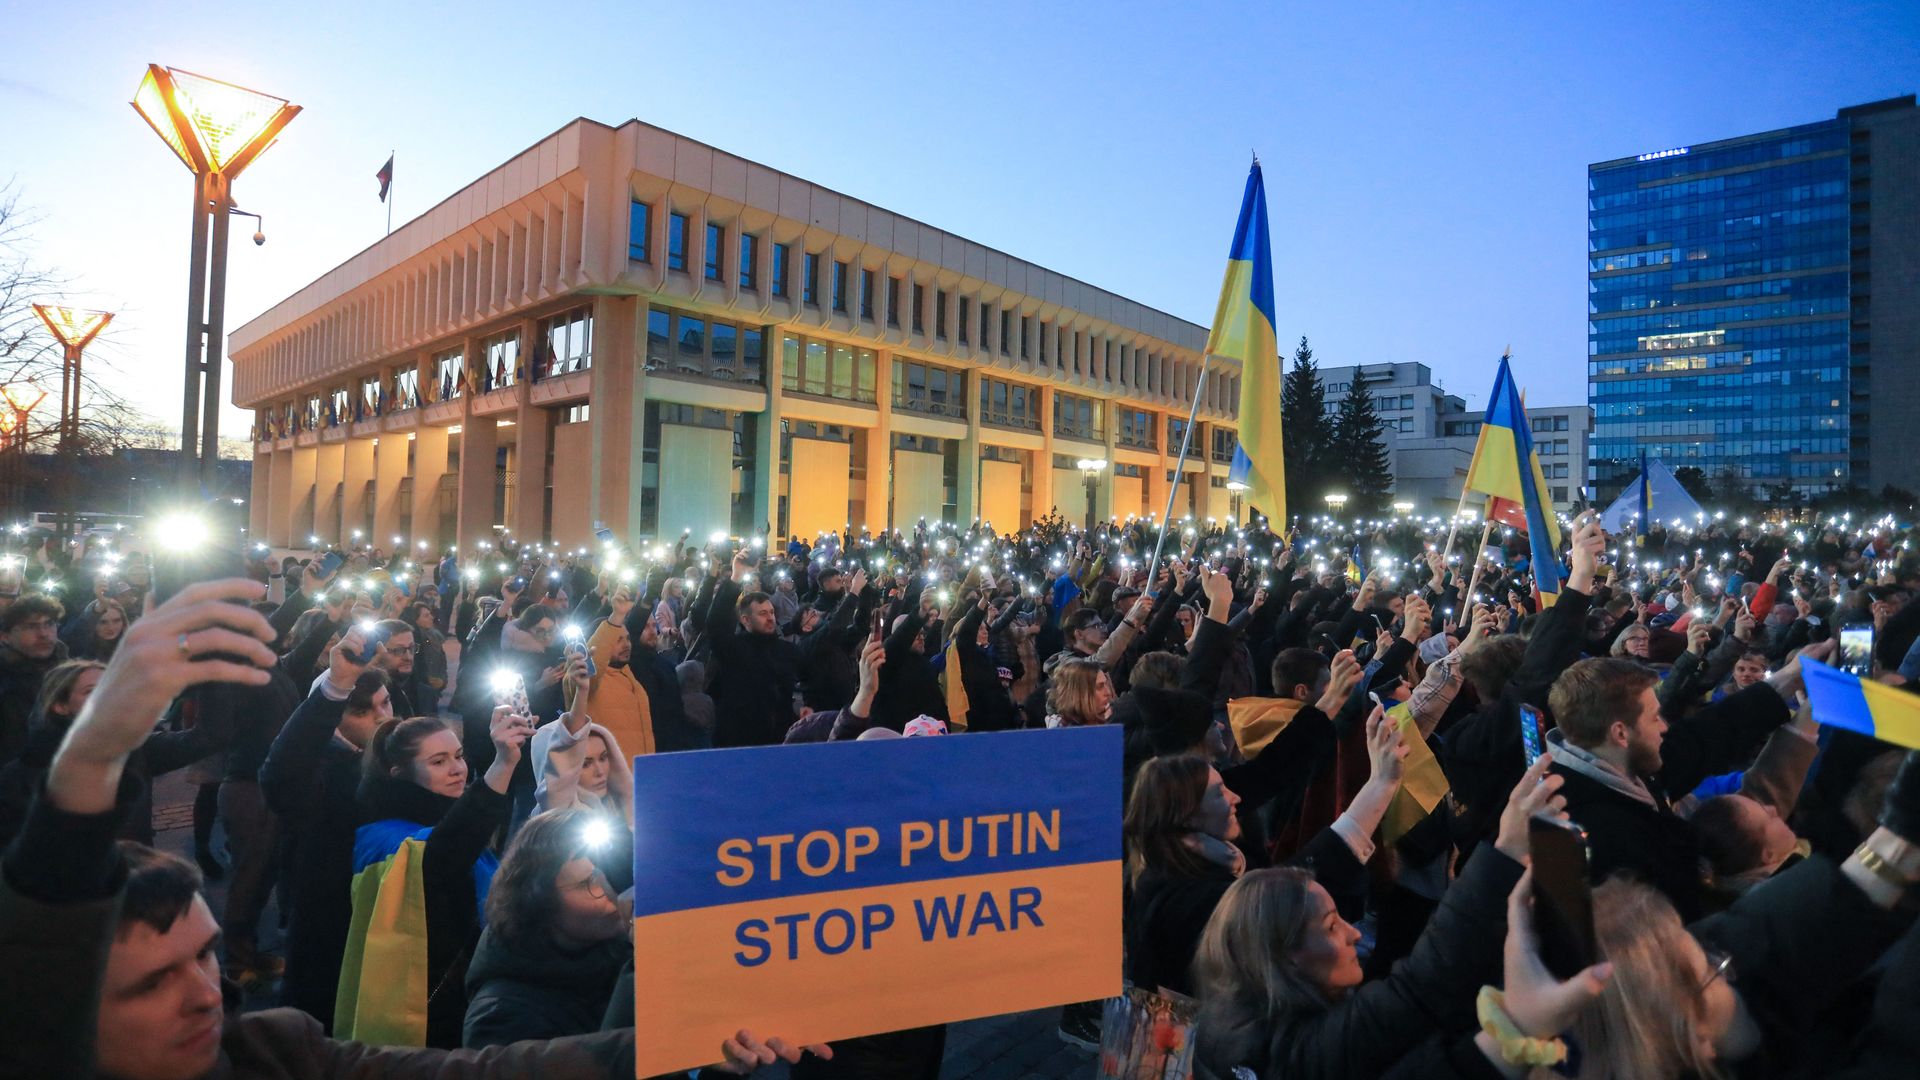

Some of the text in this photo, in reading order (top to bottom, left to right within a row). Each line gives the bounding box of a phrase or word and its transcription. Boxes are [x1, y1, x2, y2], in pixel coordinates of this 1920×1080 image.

[716, 809, 1061, 887] STOP PUTIN
[734, 886, 1044, 967] STOP WAR
